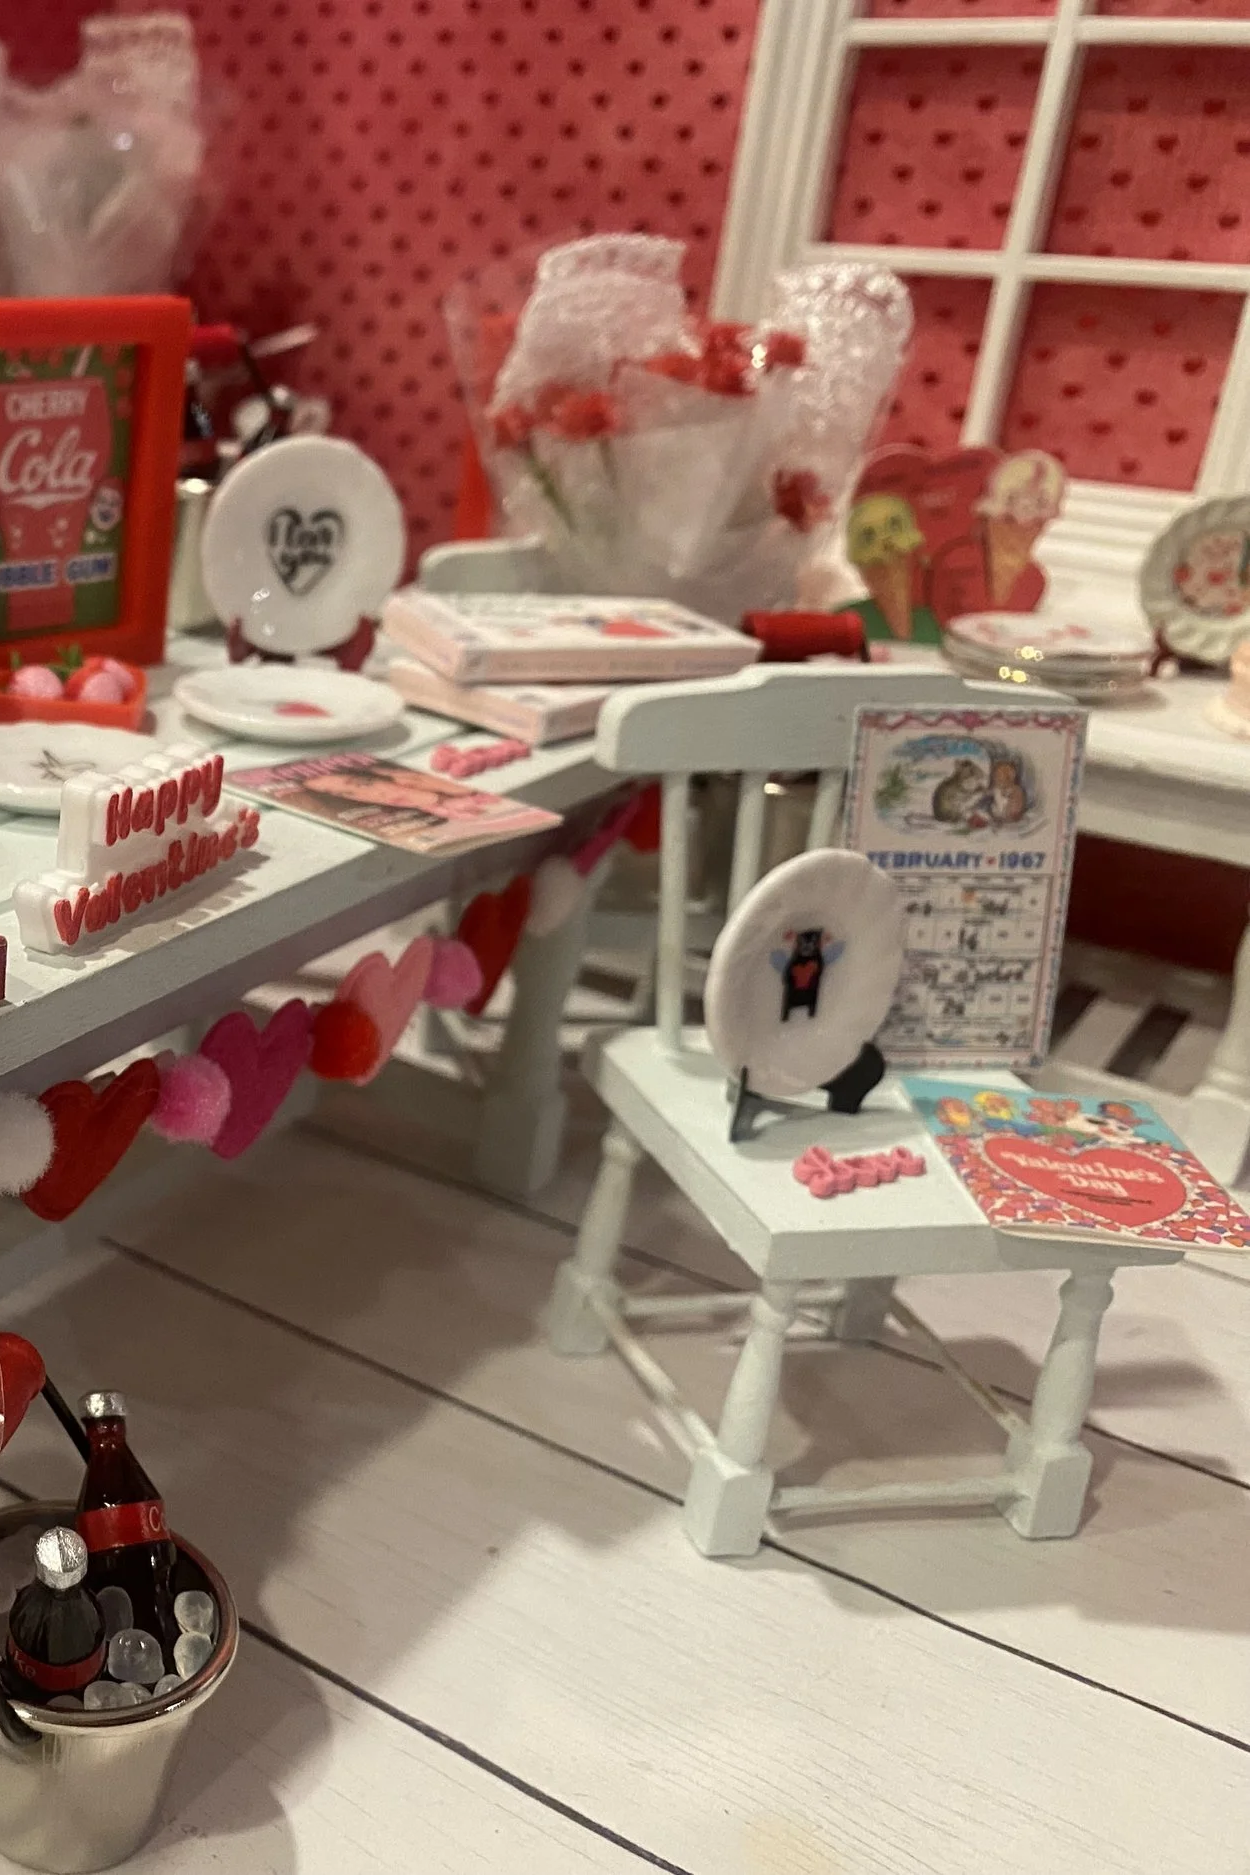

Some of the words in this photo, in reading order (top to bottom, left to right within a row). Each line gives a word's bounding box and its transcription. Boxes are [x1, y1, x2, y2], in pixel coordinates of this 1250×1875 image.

[5, 388, 90, 421] CHERRY
[106, 755, 225, 847] Happy
[1057, 1173, 1129, 1197] Day
